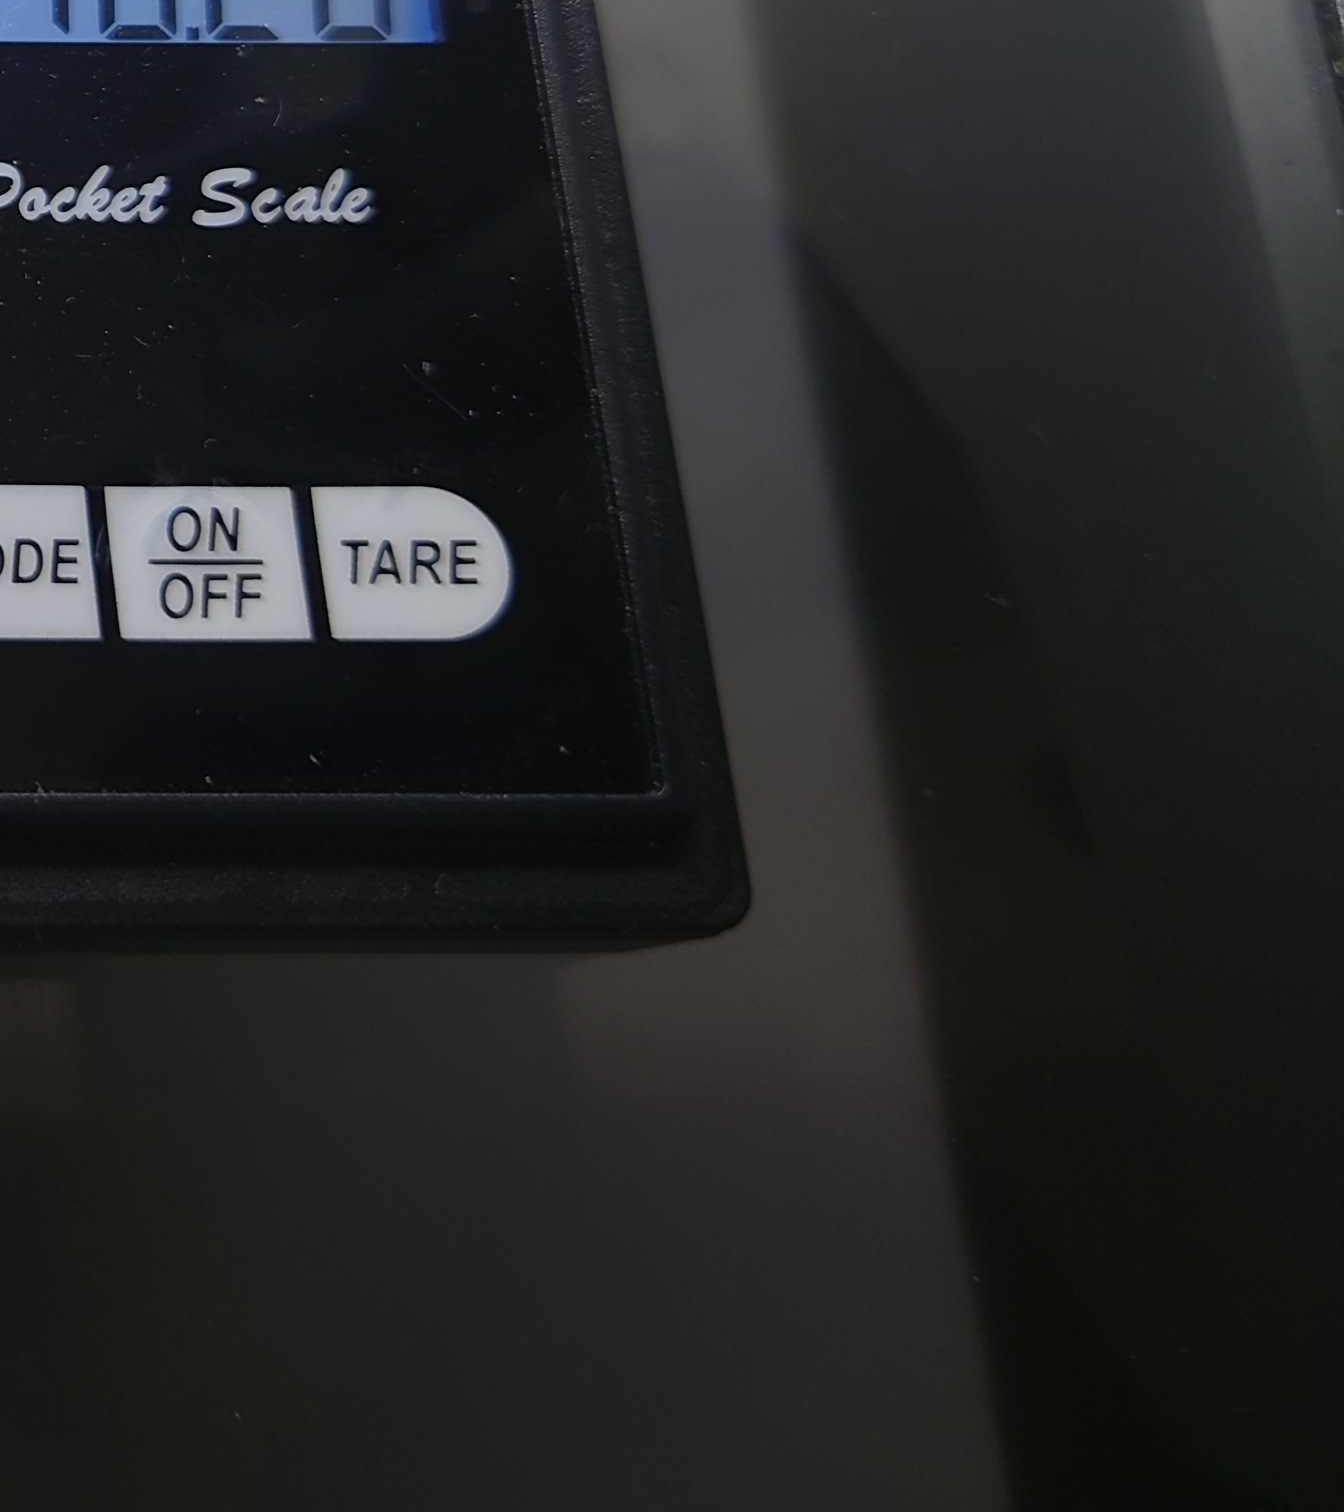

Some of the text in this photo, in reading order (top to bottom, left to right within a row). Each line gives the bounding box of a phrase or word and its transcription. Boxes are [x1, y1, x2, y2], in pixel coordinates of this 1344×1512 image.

[192, 167, 374, 228] Scale
[166, 506, 240, 552] ON
[340, 539, 479, 586] TARE
[159, 573, 262, 620] OFF
